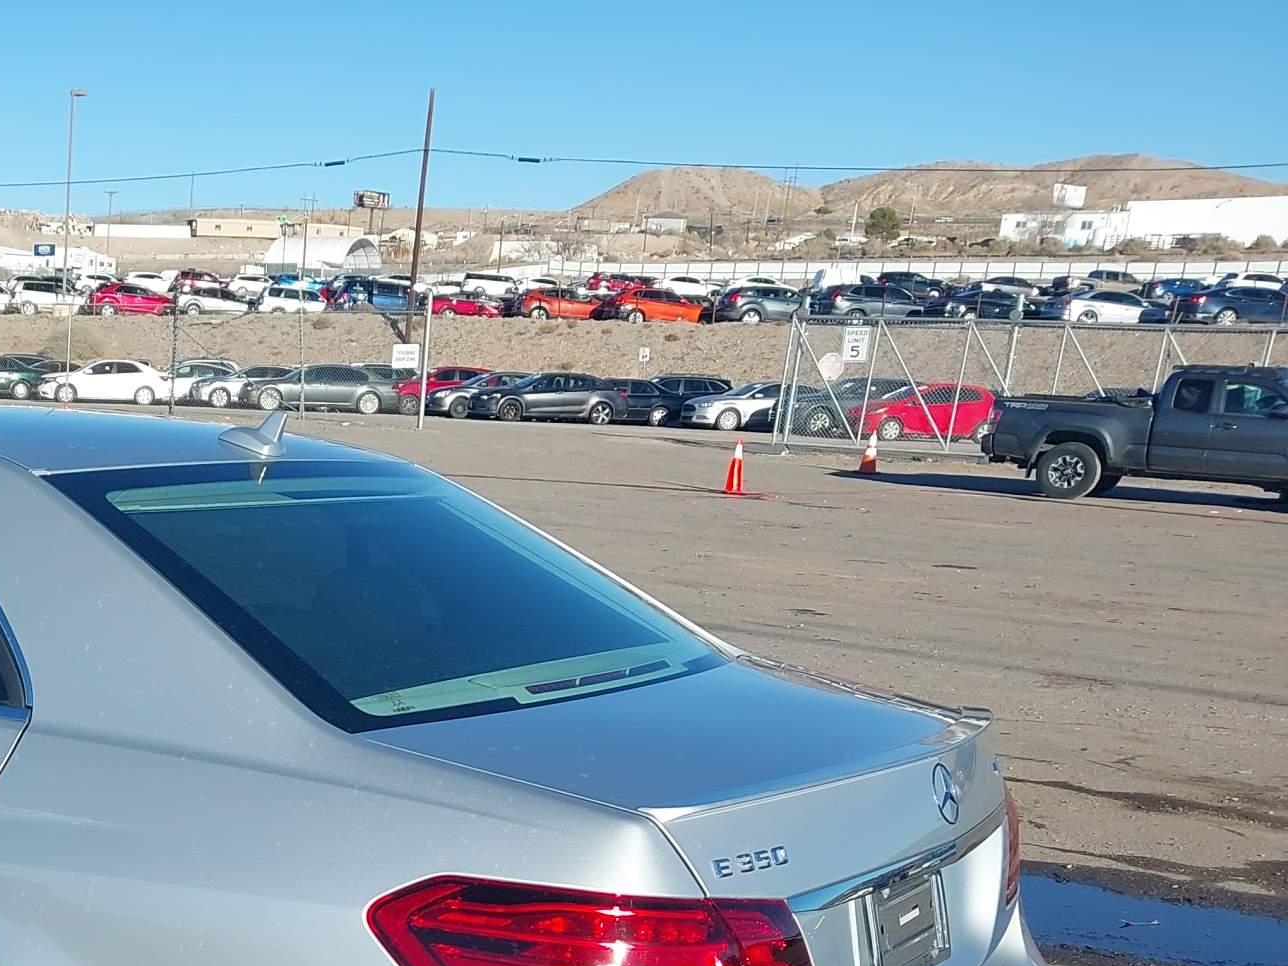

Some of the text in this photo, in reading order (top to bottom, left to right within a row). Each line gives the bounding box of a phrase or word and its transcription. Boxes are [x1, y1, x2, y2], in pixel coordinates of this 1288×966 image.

[850, 345, 860, 358] 5
[1003, 401, 1027, 409] TRD
[712, 846, 789, 879] E 350
